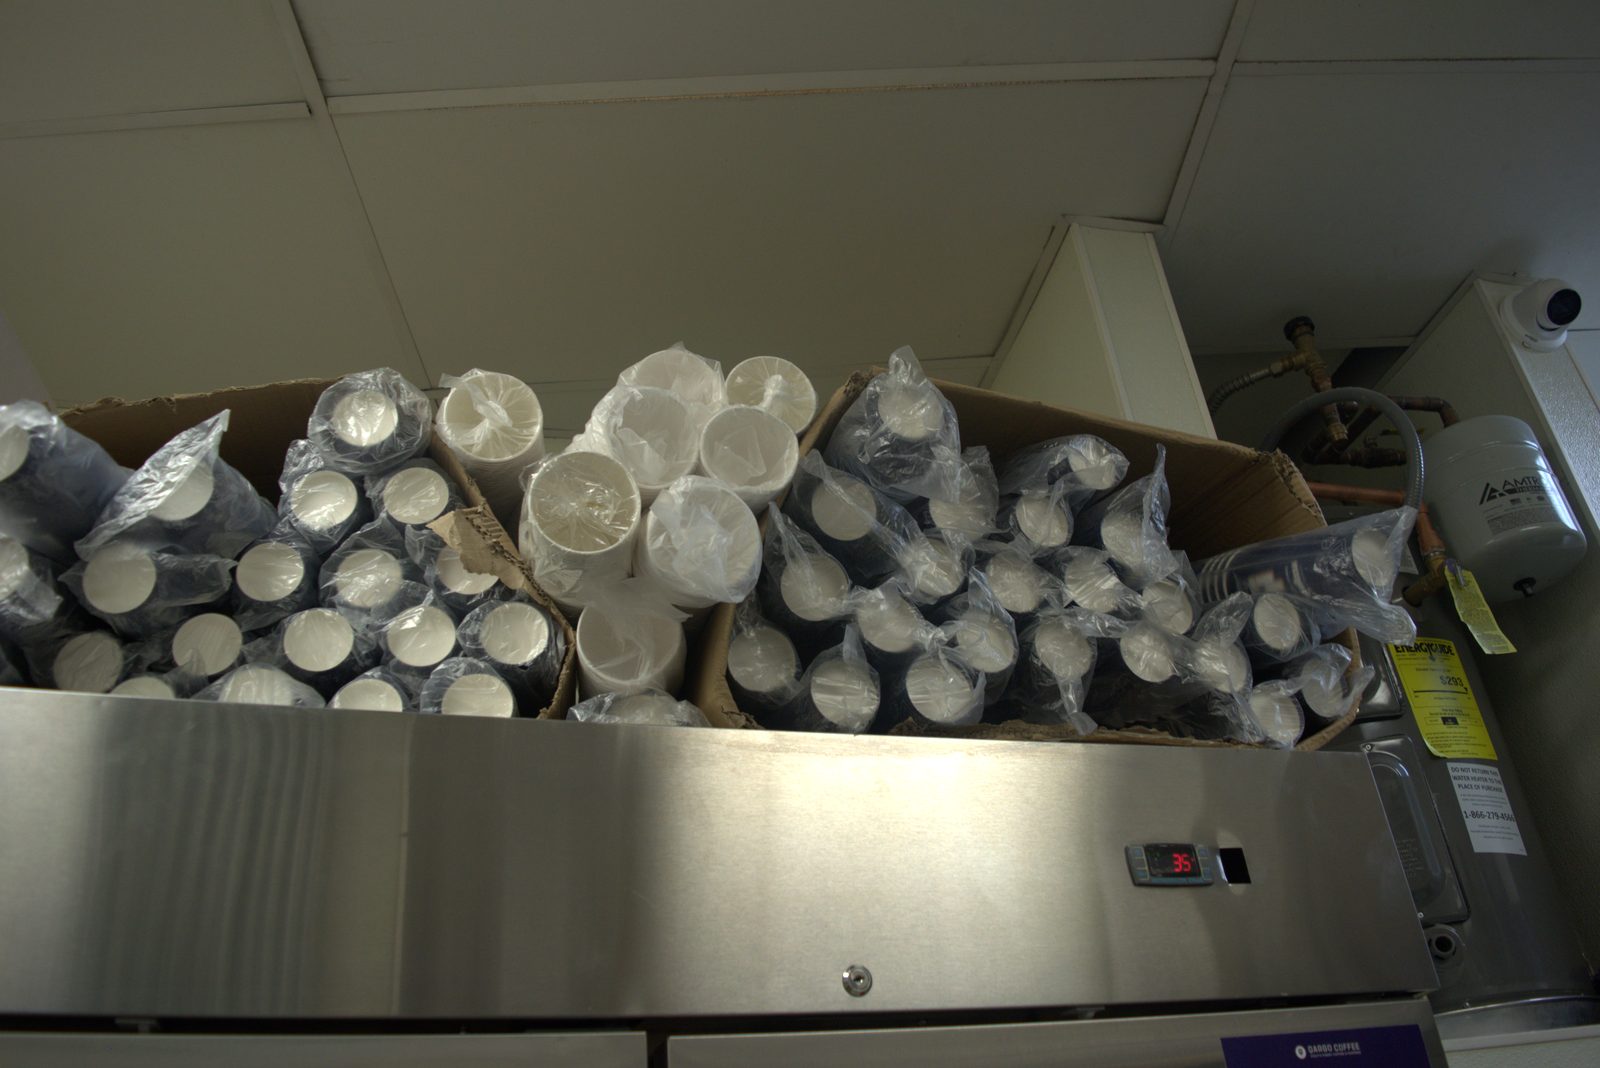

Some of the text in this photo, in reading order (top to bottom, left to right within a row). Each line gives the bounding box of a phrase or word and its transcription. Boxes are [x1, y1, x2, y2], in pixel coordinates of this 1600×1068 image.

[1503, 476, 1540, 489] AMTR
[1440, 675, 1464, 687] $293
[1471, 768, 1490, 776] RETURN
[1471, 776, 1489, 784] HEATER
[1481, 785, 1503, 793] PURCHASE
[1172, 853, 1192, 873] 35
[1333, 1042, 1360, 1052] COFFEE
